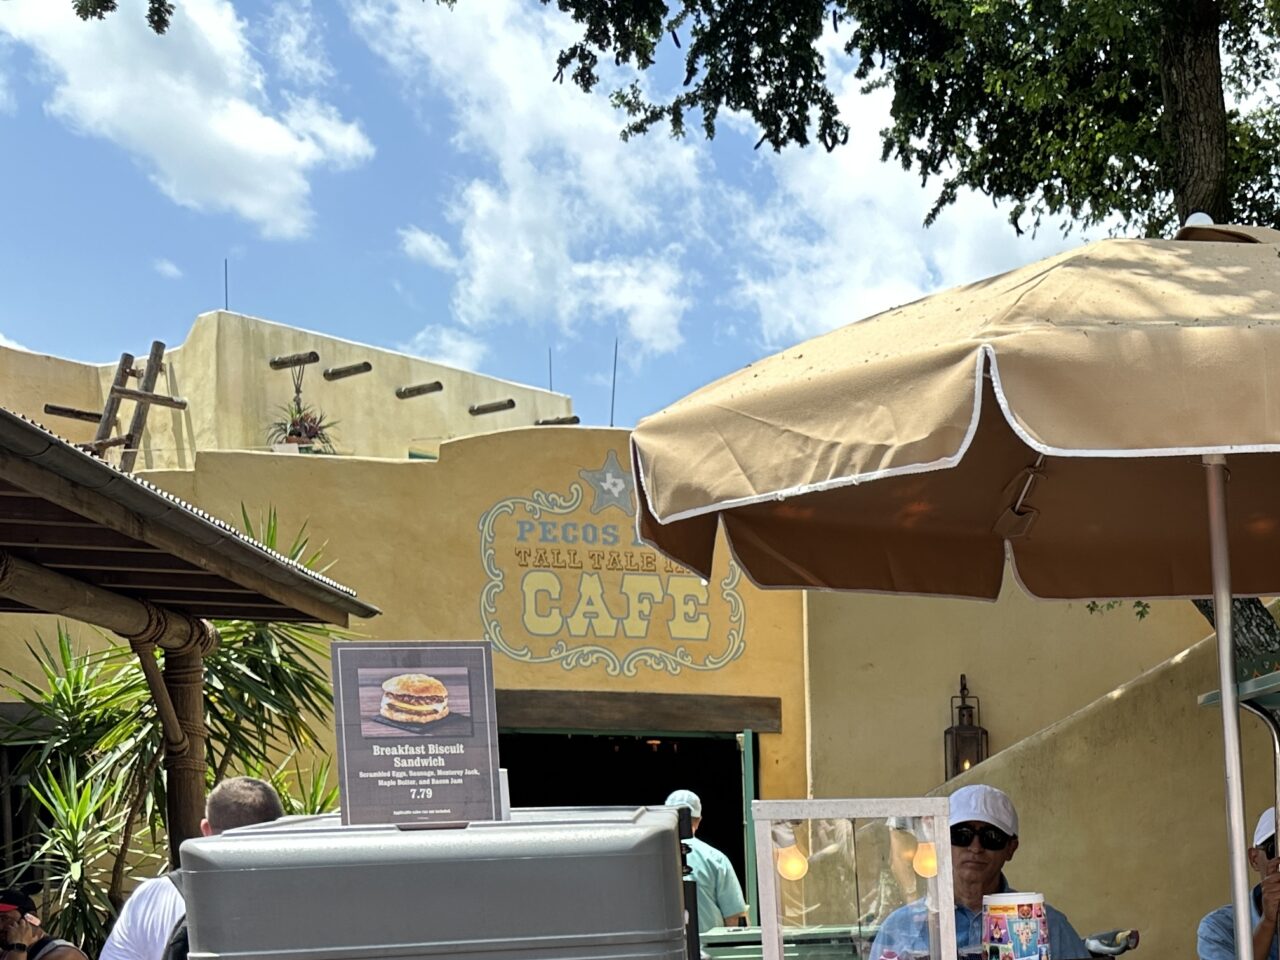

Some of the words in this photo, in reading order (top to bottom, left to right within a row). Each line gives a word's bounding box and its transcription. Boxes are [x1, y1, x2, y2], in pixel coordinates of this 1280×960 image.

[516, 520, 619, 545] PECOS
[515, 547, 583, 569] TALL
[589, 550, 657, 572] TALE
[520, 569, 711, 640] CAFE
[372, 744, 426, 756] Breakfast
[427, 743, 465, 754] Biscuit
[393, 756, 445, 768] Sandwich
[410, 788, 433, 799] 7.79
